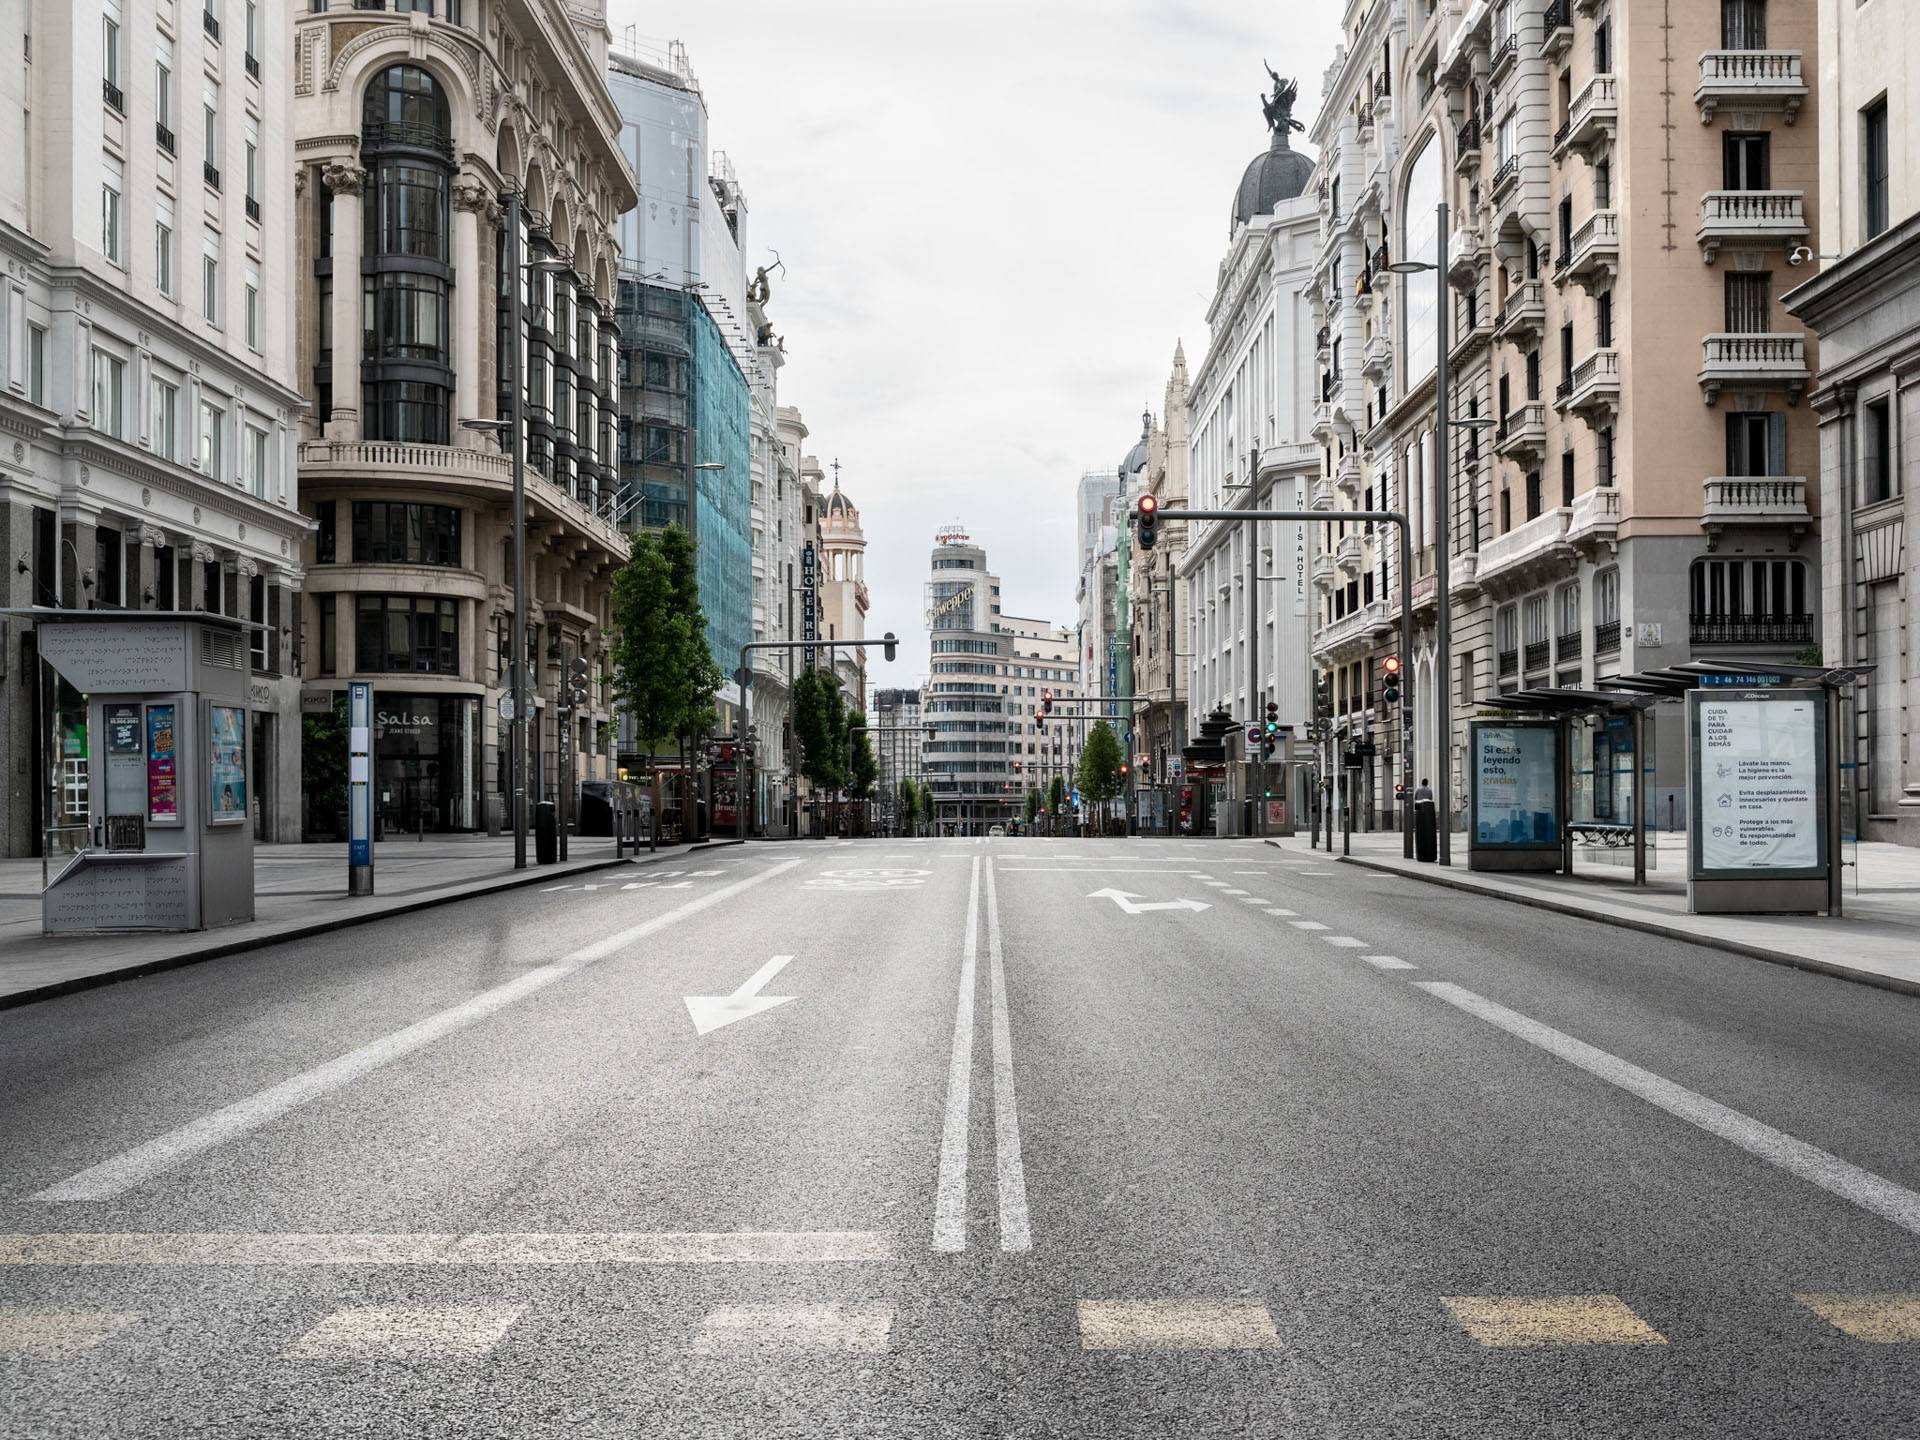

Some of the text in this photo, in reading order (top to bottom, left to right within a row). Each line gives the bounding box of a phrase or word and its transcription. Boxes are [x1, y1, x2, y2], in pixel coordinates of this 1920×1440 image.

[1297, 525, 1304, 541] IS
[803, 566, 814, 616] HOTEL
[250, 684, 270, 699] KIKO
[304, 696, 328, 704] KIKO
[377, 711, 433, 726] Salsa
[1484, 746, 1493, 754] Si
[1484, 756, 1520, 765] leyendo
[1483, 767, 1506, 775] esto,
[1483, 776, 1517, 785] gracias
